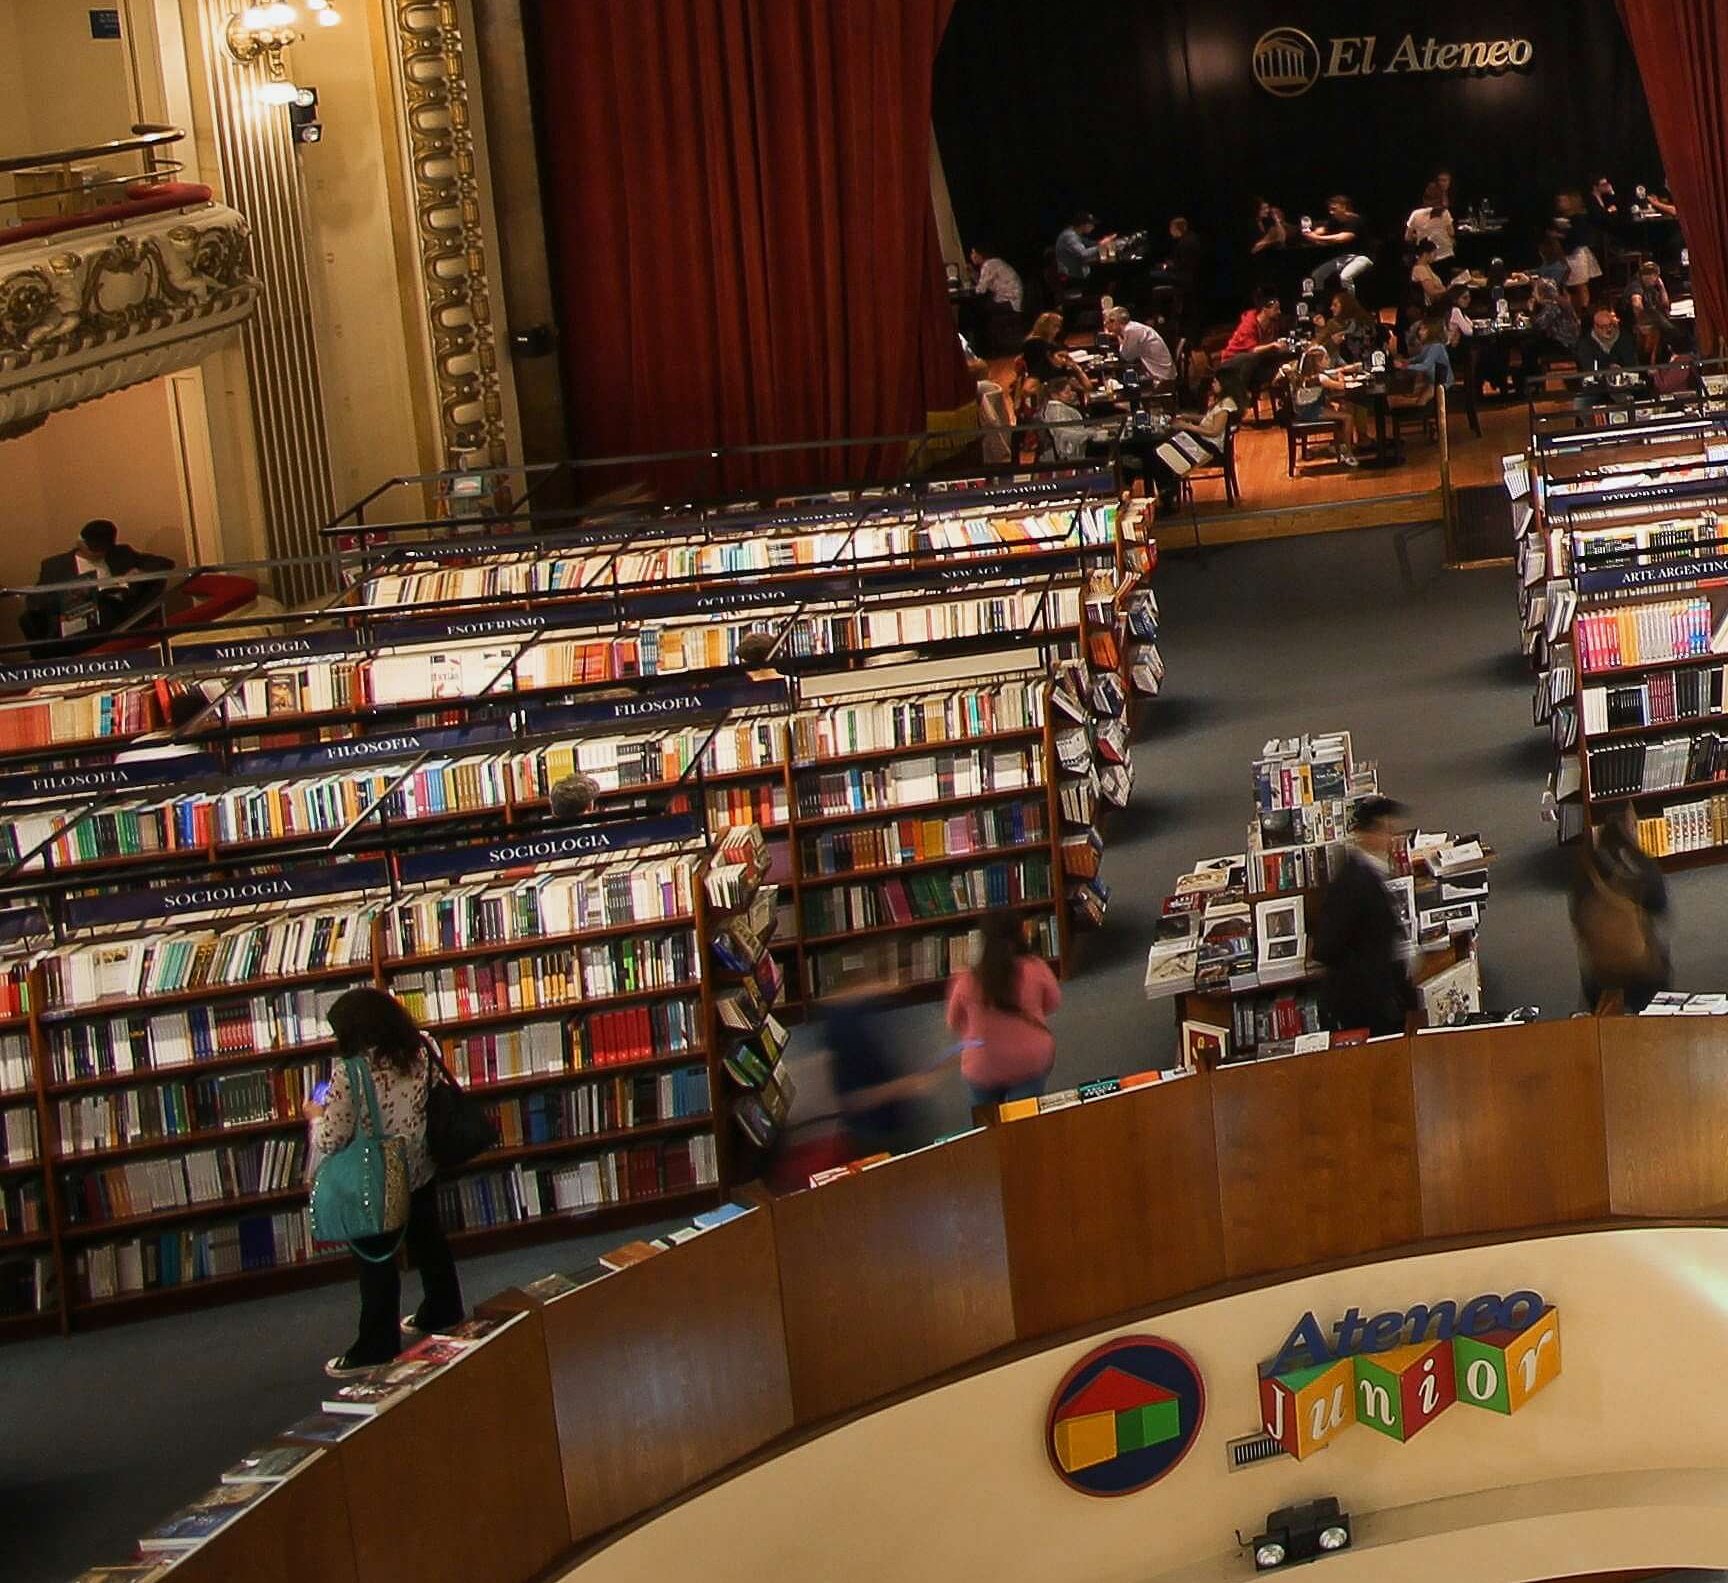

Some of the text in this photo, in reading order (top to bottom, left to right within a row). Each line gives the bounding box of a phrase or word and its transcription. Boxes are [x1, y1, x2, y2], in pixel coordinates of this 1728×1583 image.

[1323, 33, 1533, 78] El Ateneo
[1622, 567, 1656, 583] ARTE
[446, 616, 546, 635] ESOTERISMO
[215, 639, 311, 659] MITOLOGIA
[614, 695, 702, 717] FILOSOFIA
[327, 736, 420, 759] FILOSOFIA
[32, 769, 129, 791] FILOSOFIA
[489, 833, 611, 863] SOCIOLOGIA
[164, 879, 293, 909] SOCIOLOGIA
[1266, 1289, 1546, 1376] Ateneo
